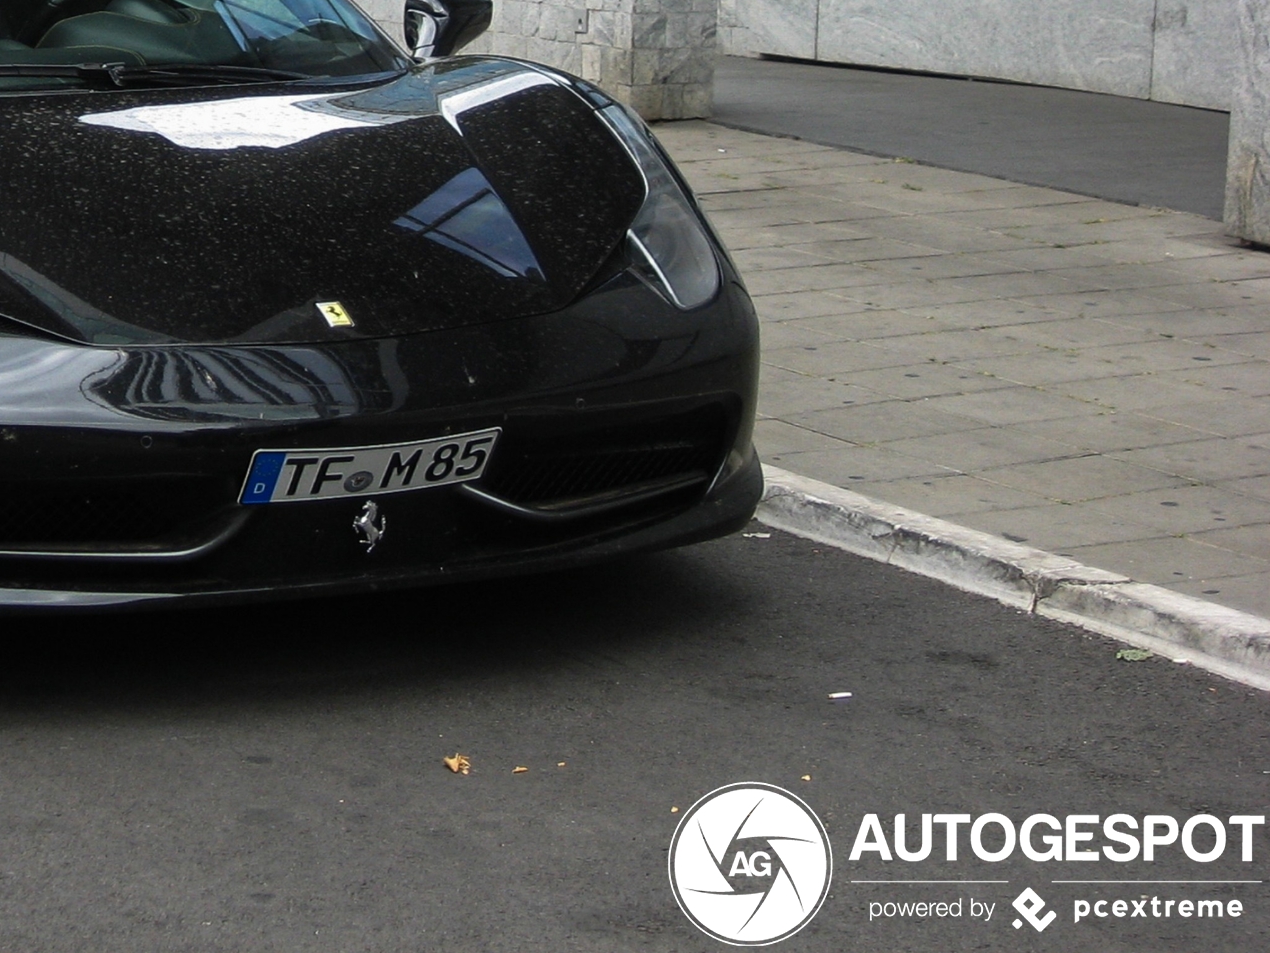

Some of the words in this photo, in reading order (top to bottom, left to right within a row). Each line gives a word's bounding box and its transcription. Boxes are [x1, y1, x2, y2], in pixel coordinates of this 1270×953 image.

[285, 456, 355, 496] TF
[425, 437, 494, 482] 85
[253, 482, 266, 494] D
